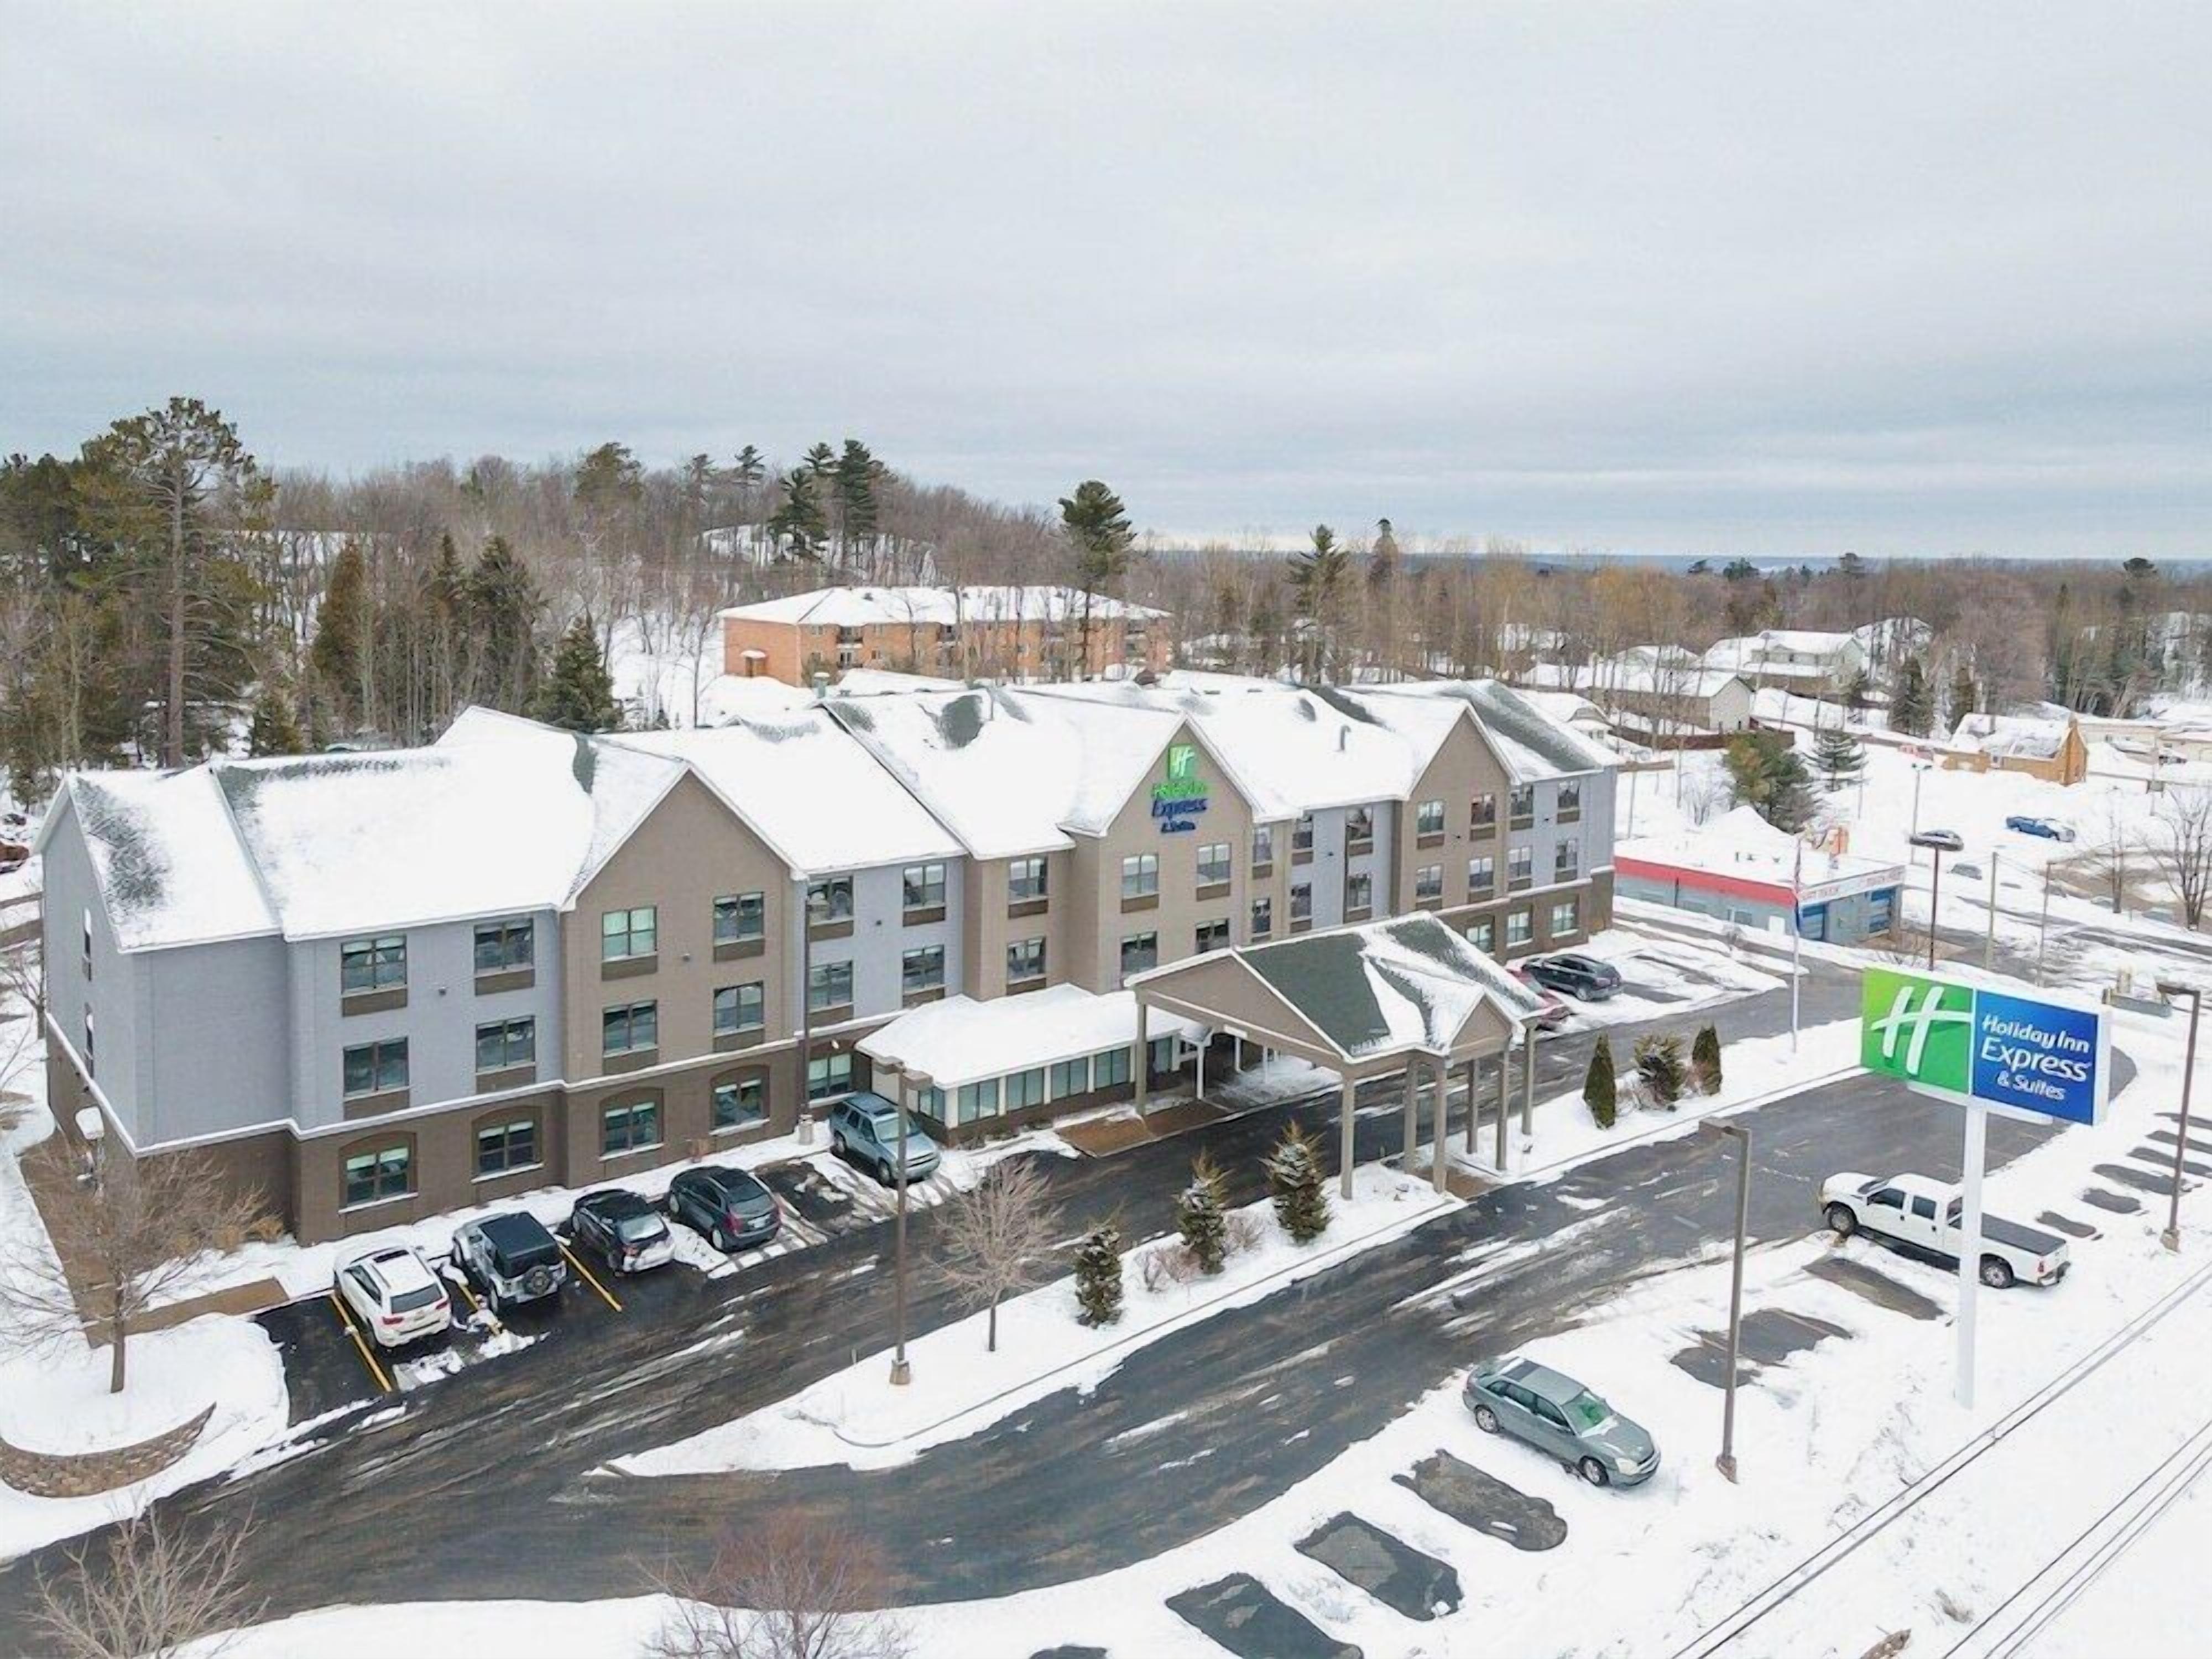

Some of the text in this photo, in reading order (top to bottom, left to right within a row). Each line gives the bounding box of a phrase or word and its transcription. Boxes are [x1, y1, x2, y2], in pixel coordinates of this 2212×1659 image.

[1982, 1014, 2090, 1053] Holiday Inn
[1981, 1036, 2093, 1082] Express
[1997, 1071, 2066, 1100] & Suites
